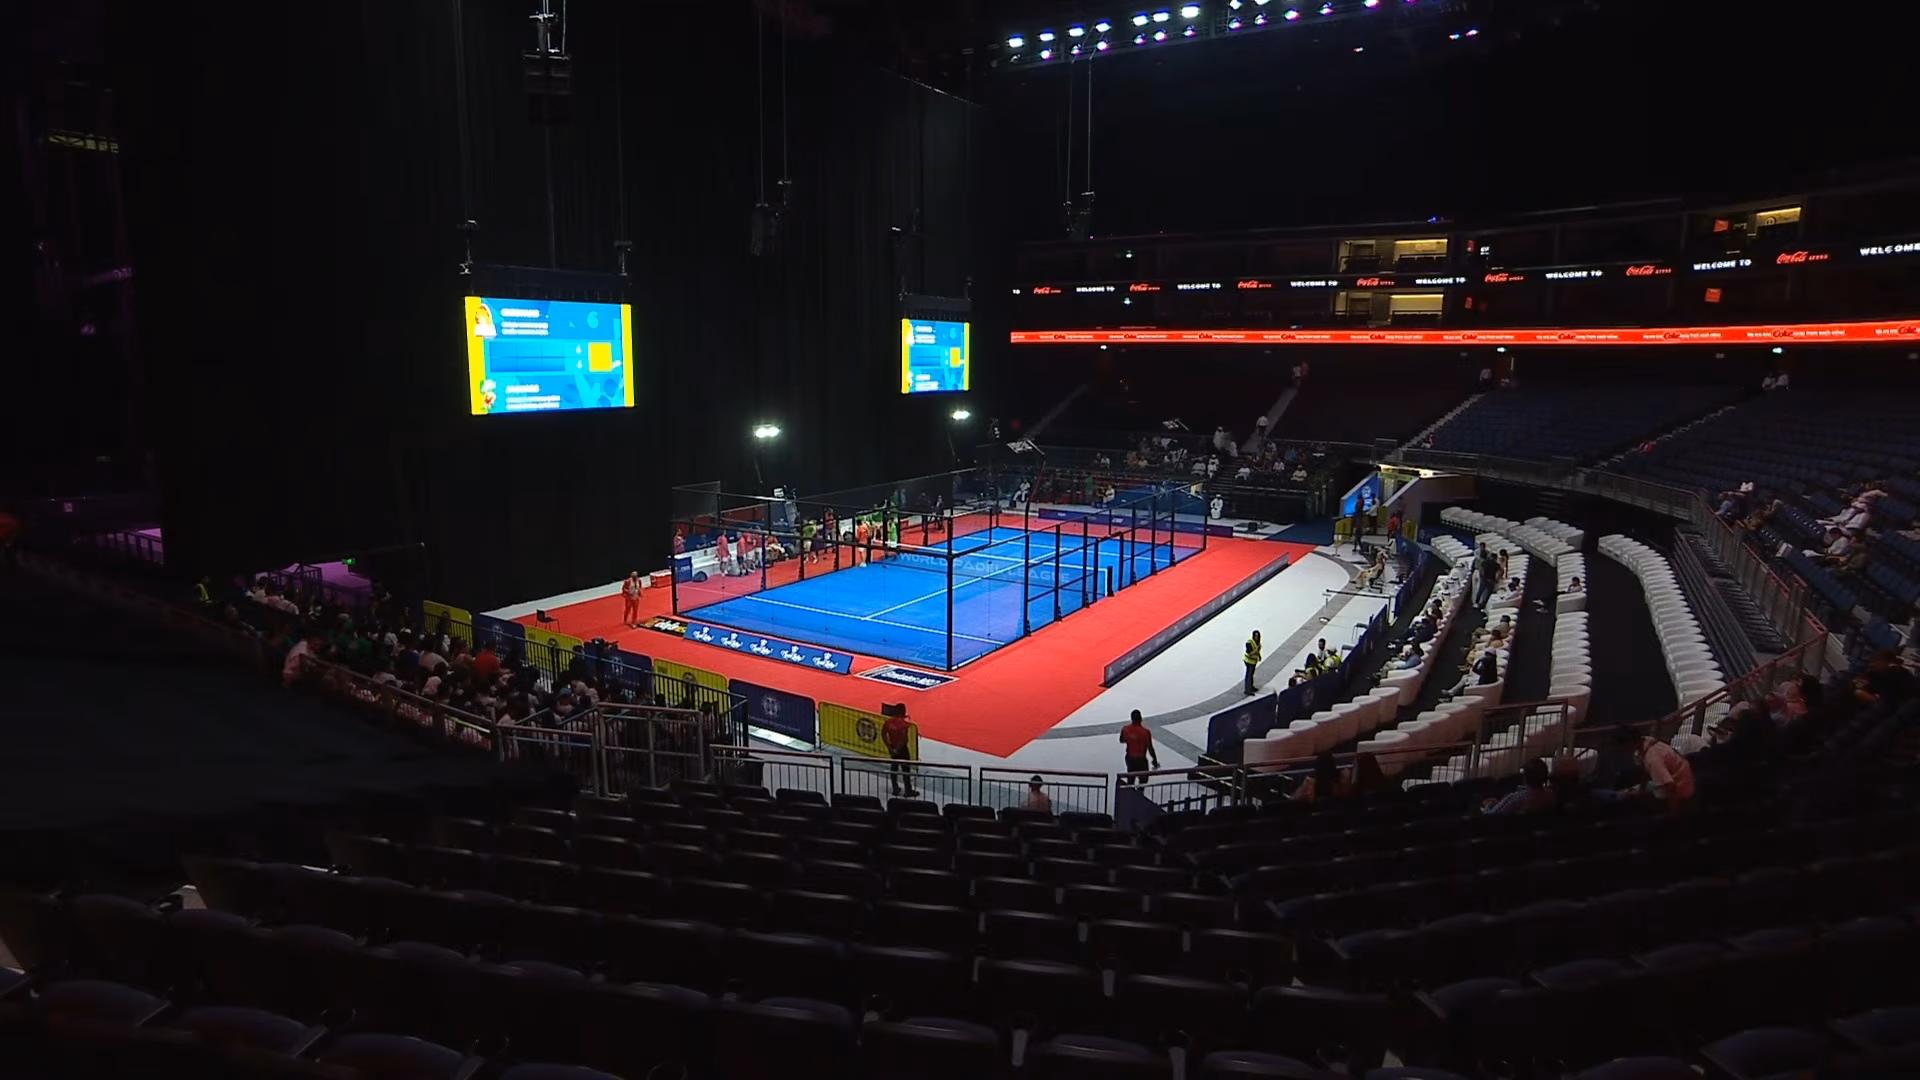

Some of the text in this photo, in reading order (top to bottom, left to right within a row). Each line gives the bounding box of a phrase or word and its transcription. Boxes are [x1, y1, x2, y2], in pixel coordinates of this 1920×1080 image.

[1860, 242, 1920, 256] WELCOME
[1693, 259, 1752, 271] WELCOME TO
[1415, 277, 1453, 285] WELCOME
[1545, 271, 1588, 279] WELCOME
[900, 552, 949, 567] WORLD
